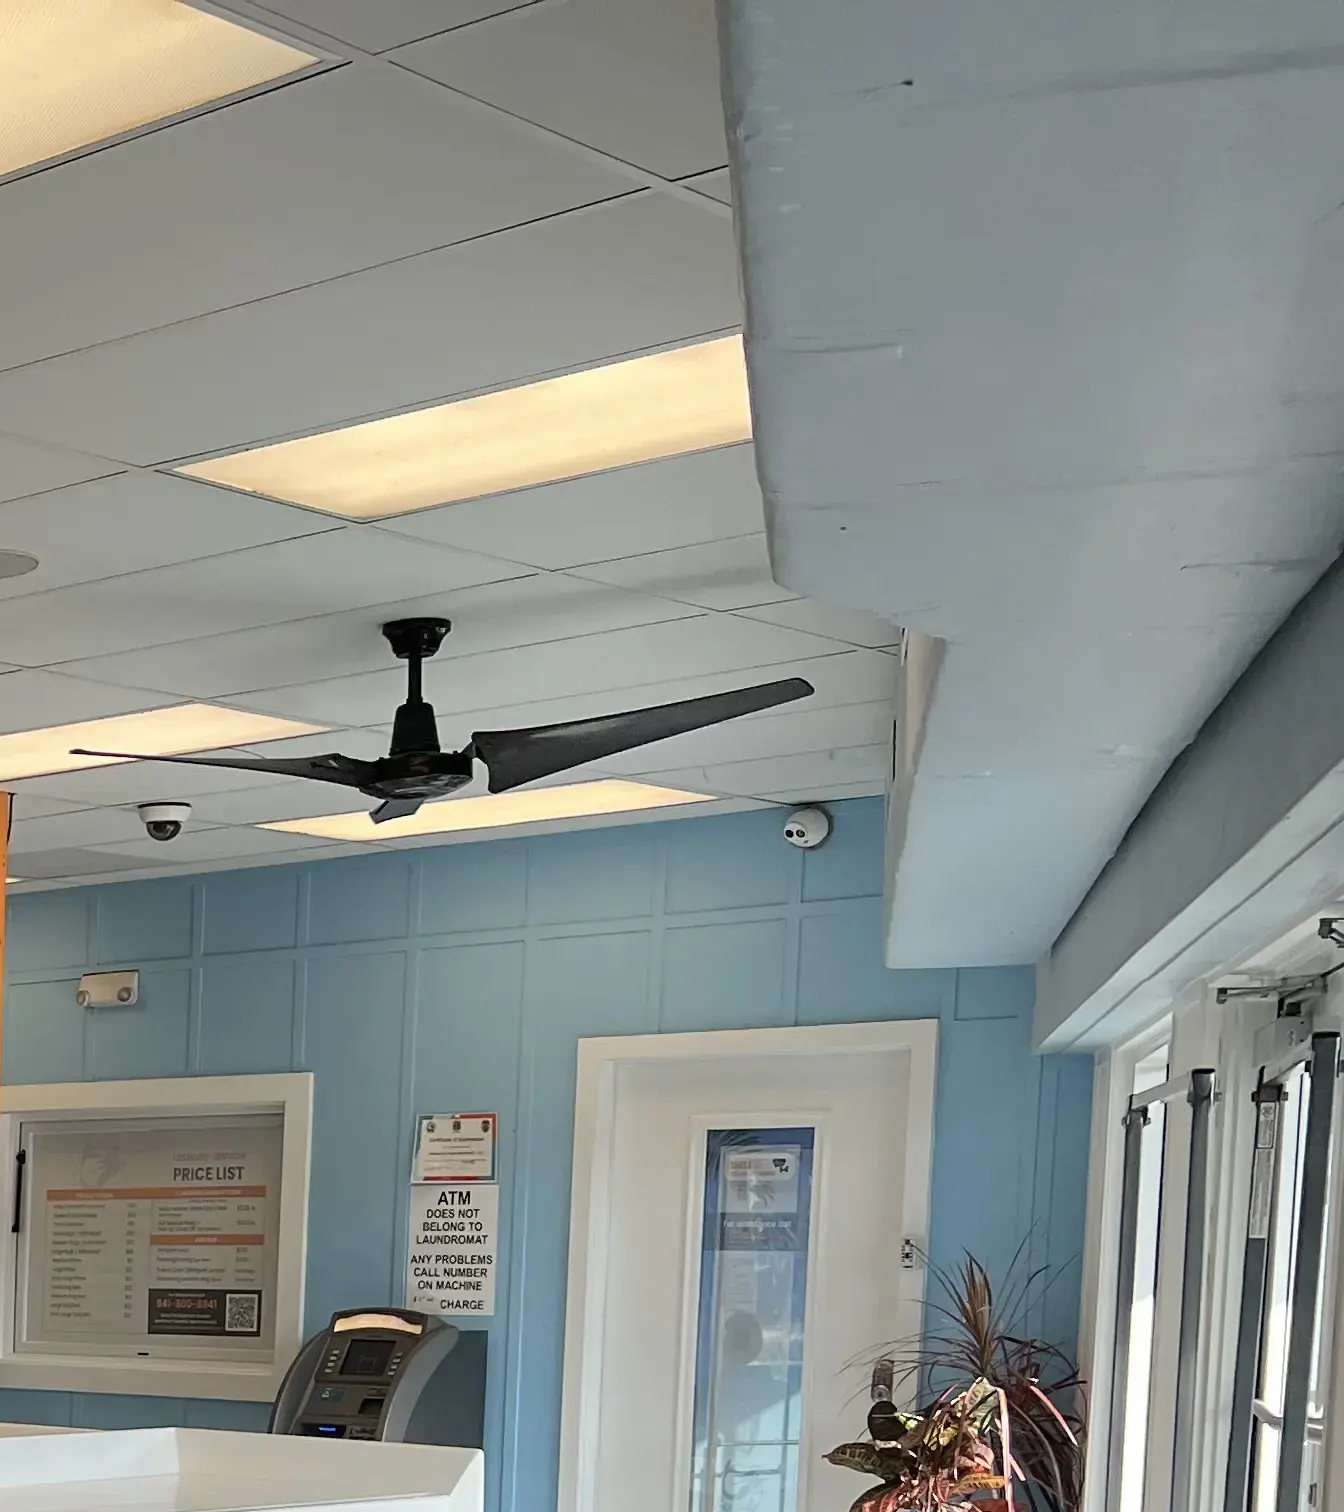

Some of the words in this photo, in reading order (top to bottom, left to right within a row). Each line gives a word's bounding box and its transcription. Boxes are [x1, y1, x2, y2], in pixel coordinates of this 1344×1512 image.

[173, 1167, 213, 1181] PRICE
[216, 1166, 245, 1180] LIST
[437, 1190, 471, 1205] ATM
[426, 1208, 455, 1218] DOES
[458, 1208, 480, 1218] NOT
[422, 1221, 466, 1231] BELONG
[467, 1221, 483, 1231] TO
[416, 1234, 489, 1245] LAUNDROMAT
[411, 1254, 432, 1264] ANY
[435, 1254, 493, 1265] PROBLEMS
[413, 1267, 441, 1277] CALL
[443, 1267, 488, 1277] NUMBER
[417, 1280, 433, 1290] ON
[435, 1280, 483, 1291] MACHINE
[440, 1299, 485, 1310] CHARGE
